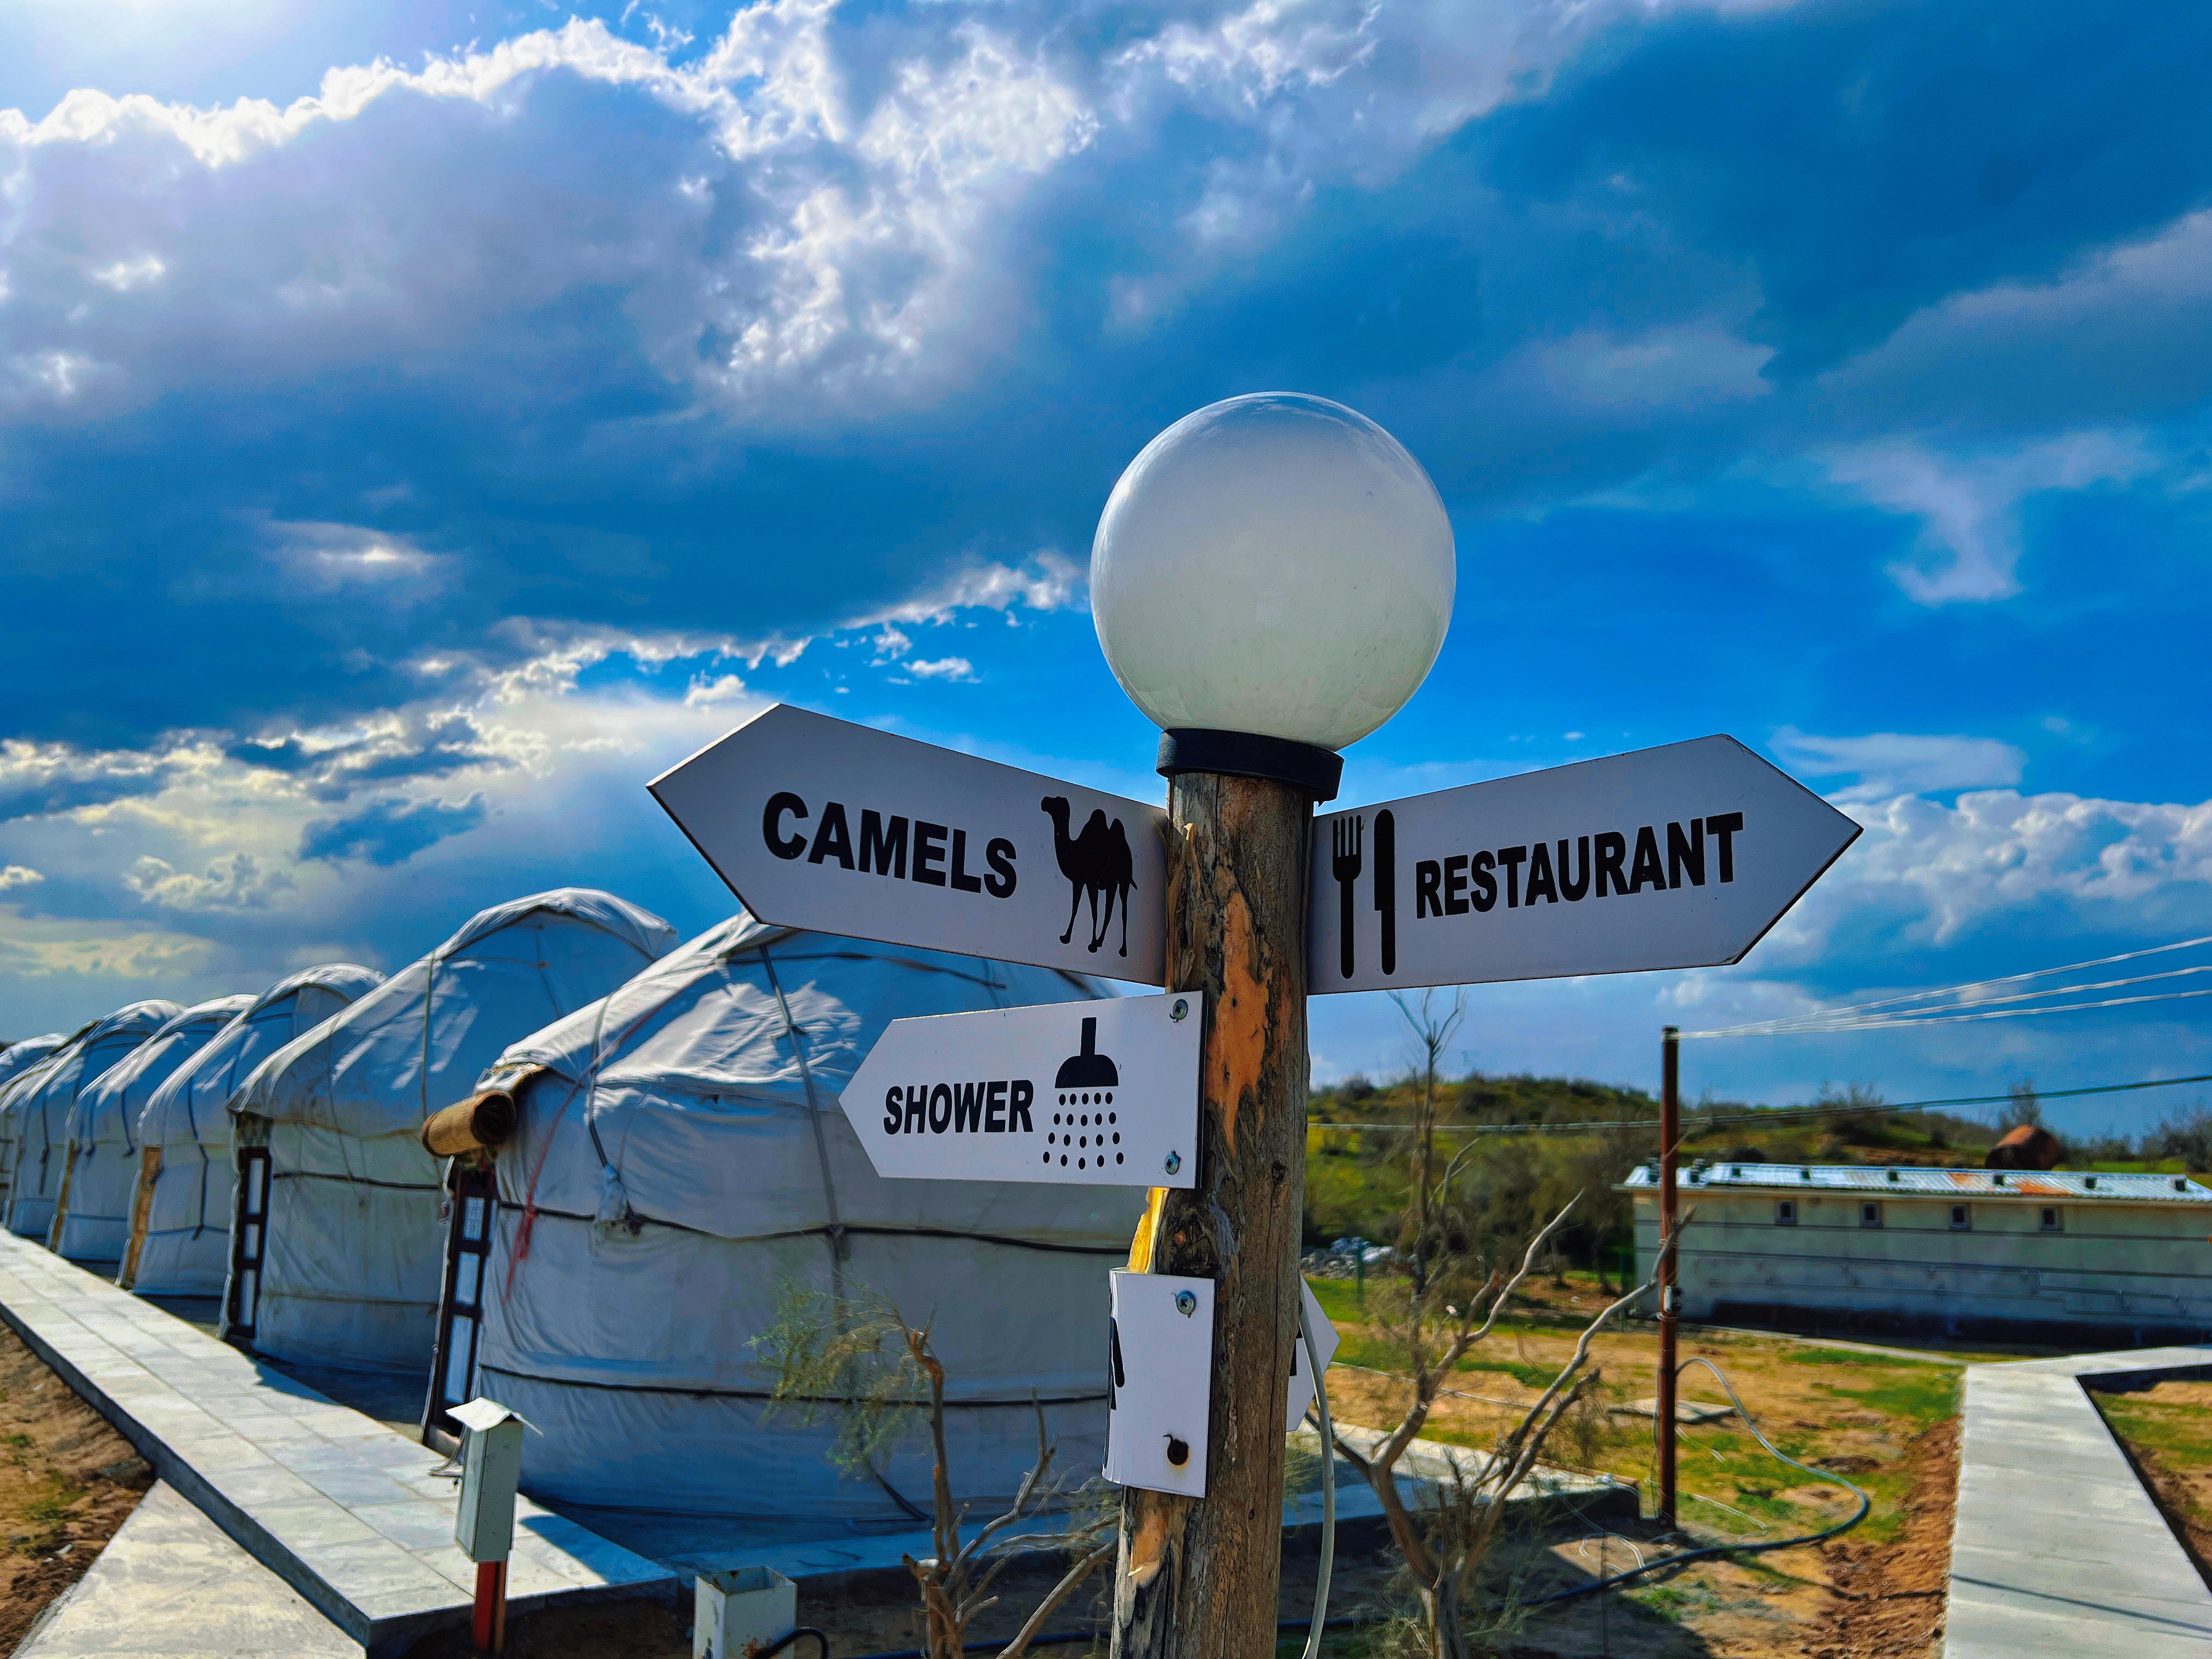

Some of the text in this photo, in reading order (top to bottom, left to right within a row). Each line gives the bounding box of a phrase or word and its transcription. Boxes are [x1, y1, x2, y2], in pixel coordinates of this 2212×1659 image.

[763, 791, 1018, 899] CAMELS
[1415, 811, 1743, 919] RESTAURANT
[883, 1079, 1034, 1135] SHOWER
